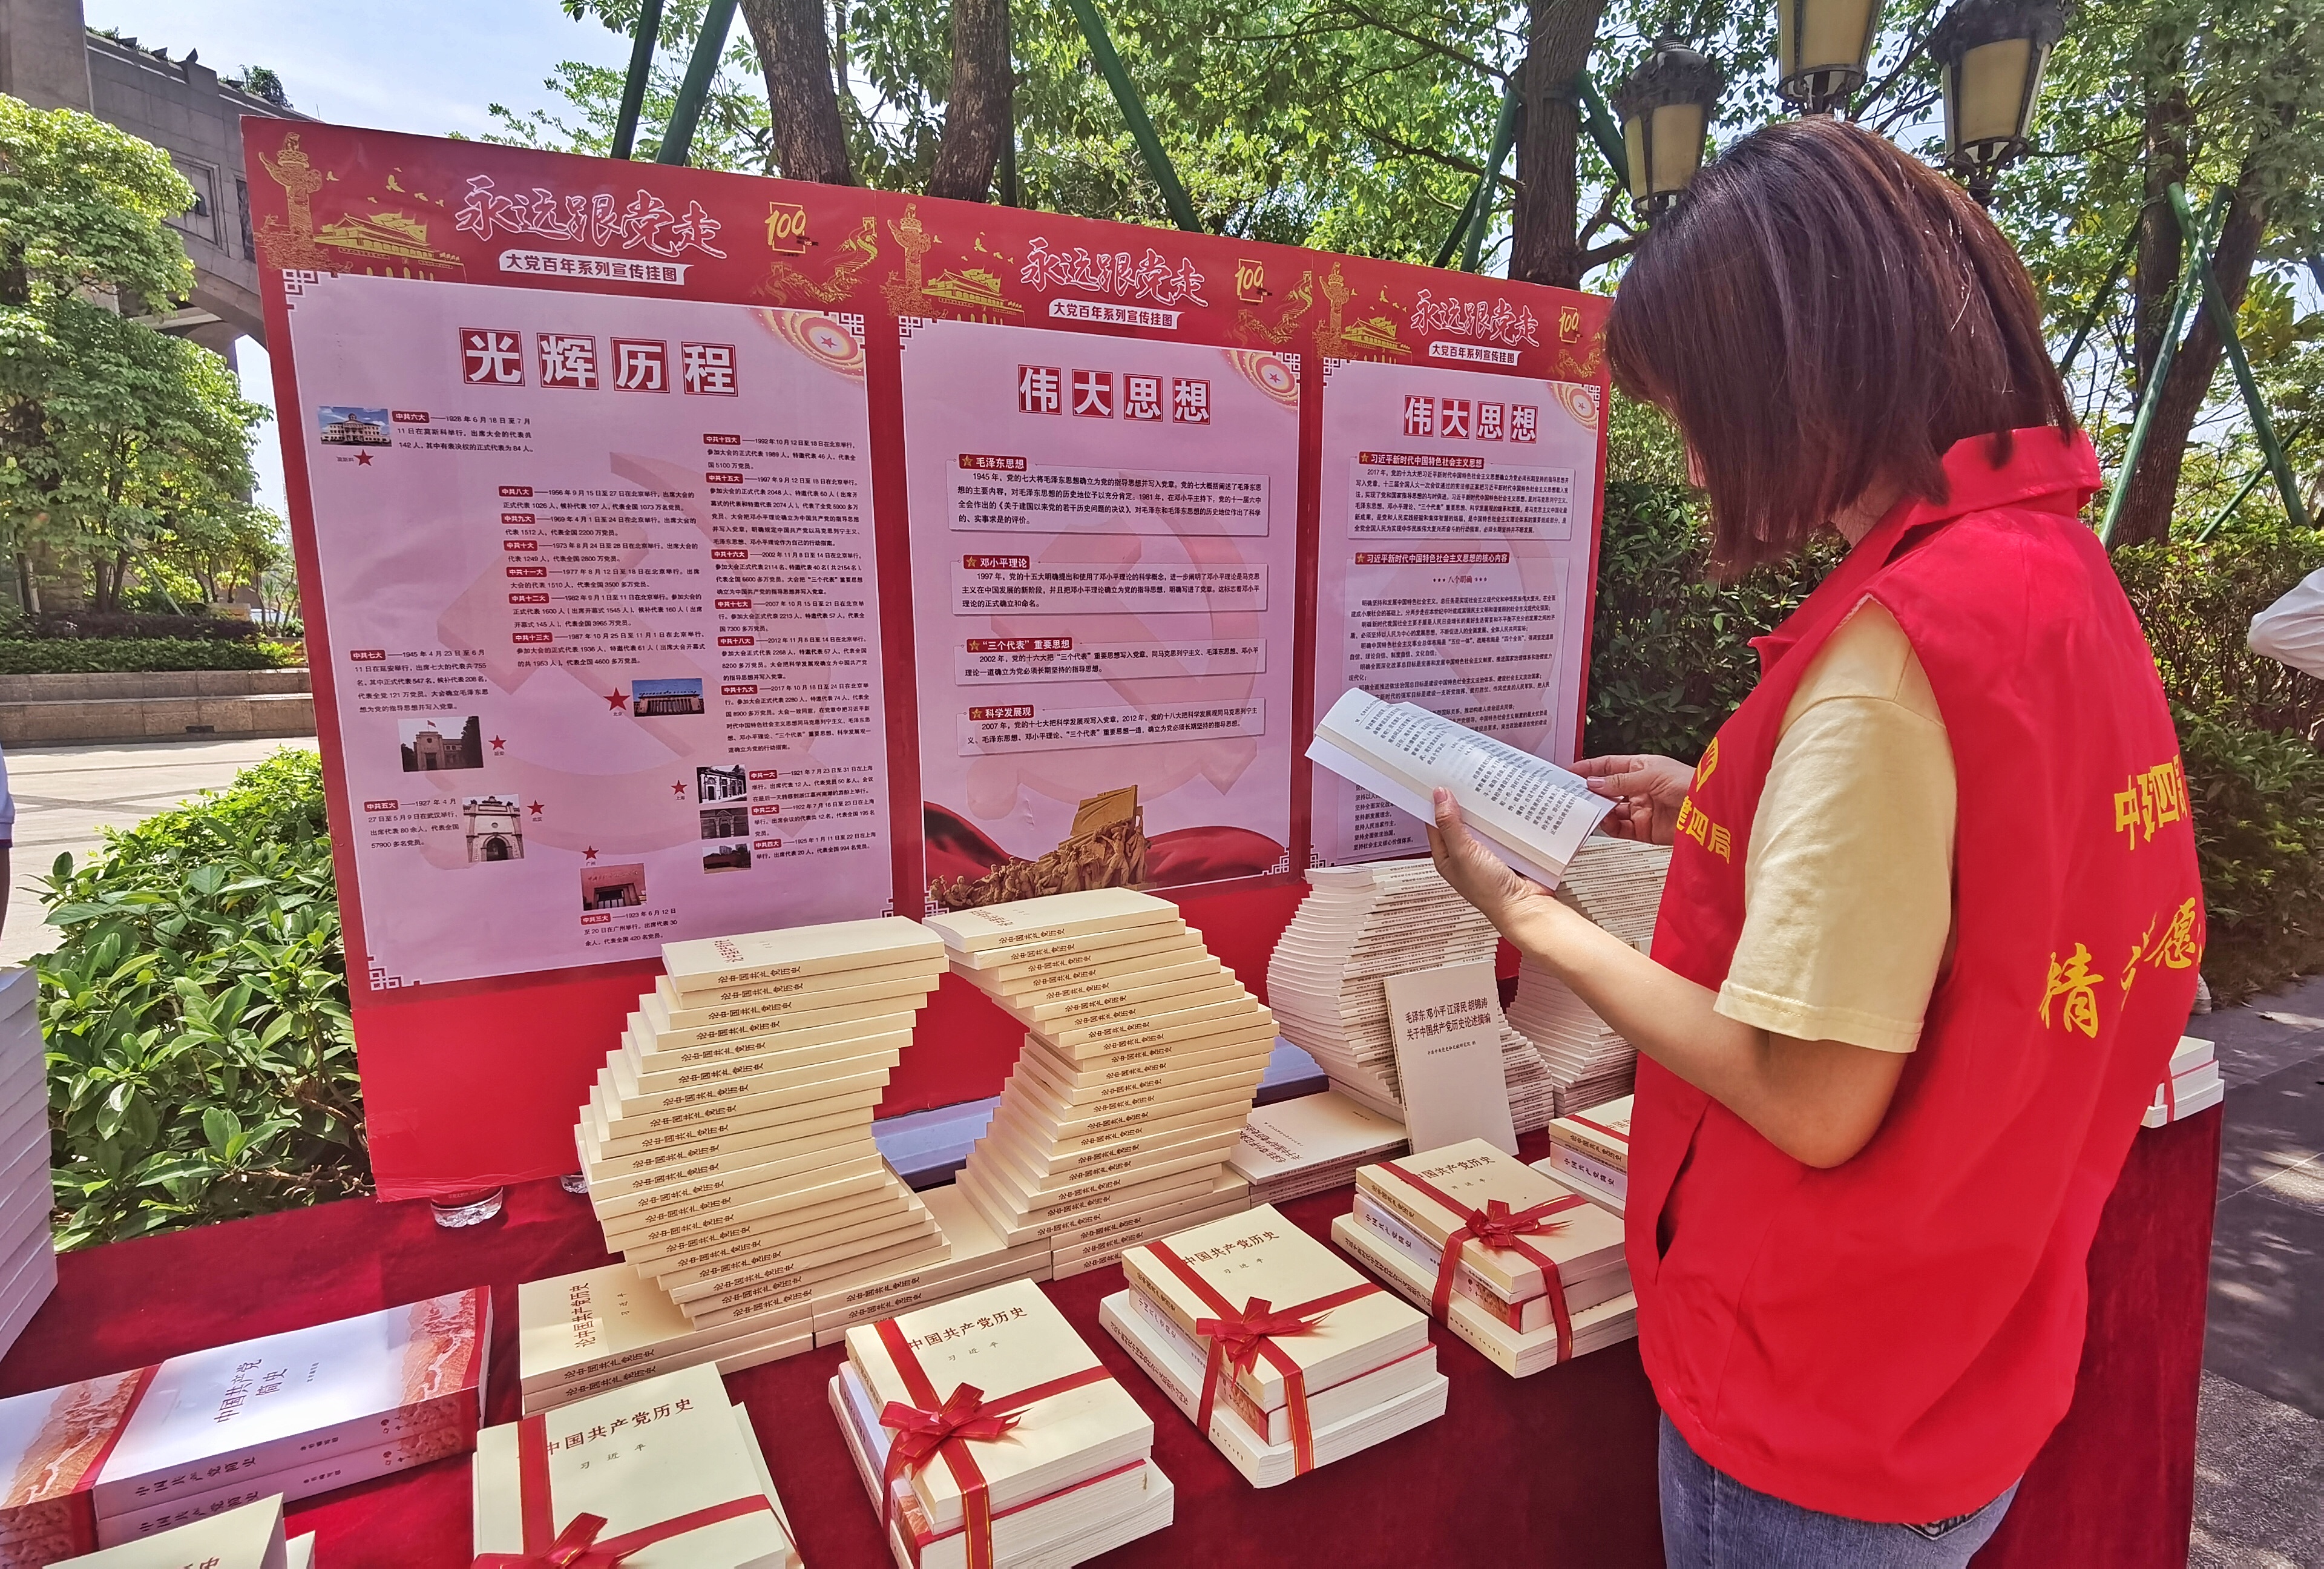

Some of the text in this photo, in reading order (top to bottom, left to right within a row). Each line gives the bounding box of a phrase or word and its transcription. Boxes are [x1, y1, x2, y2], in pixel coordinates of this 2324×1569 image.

[455, 174, 727, 258] 永远跟党走
[764, 210, 806, 246] 100
[506, 253, 678, 283] 大党百年系列宣传挂图
[1020, 237, 1209, 307] 永远跟党走
[1236, 265, 1264, 295] 100
[1054, 302, 1173, 327] 大党百年系列宣传挂图
[1411, 289, 1539, 347] 永远跟党走
[1558, 312, 1579, 337] 100
[465, 332, 735, 395] 光辉历程
[1432, 344, 1514, 364] 大党百年系列宣传挂图
[1020, 368, 1210, 423] 伟大思想
[1405, 398, 1537, 441] 伟大思想
[976, 458, 1024, 469] 毛泽东思想
[1371, 454, 1482, 468] 习近平新时代中国特色社会主义思想
[980, 558, 1027, 568] 邓小平理论
[985, 707, 1031, 717] 科学发展观
[999, 929, 1065, 944] 论中国共产党历史
[1011, 943, 1075, 959] 论中国共产党历史
[718, 965, 801, 984] 论中国共产党历史
[1028, 955, 1091, 972] 论中国共产党历史
[1033, 969, 1096, 987] 论中国共产党历史
[720, 982, 803, 1001] 论中国共产党历史
[1046, 982, 1109, 999] 论中国共产党历史
[708, 1001, 792, 1020] 论中国共产党历史
[1065, 995, 1127, 1013] 论中国共产党历史
[1405, 997, 1488, 1024] 毛泽东 邓小平 江泽民 胡锦涛
[1074, 1008, 1137, 1026] 论中国共产党历史
[1407, 1013, 1491, 1041] 关于中国共产党历史论述摘编
[696, 1020, 780, 1041] 论中国共产党历史
[1088, 1022, 1150, 1039] 论中国共产党历史
[1103, 1033, 1164, 1051] 论中国共产党历史
[681, 1041, 766, 1062] 论中国共产党历史
[1111, 1046, 1172, 1064] 论中国共产党历史
[678, 1062, 764, 1084] 论中国共产党历史
[1105, 1062, 1167, 1080] 论中国共产党历史
[663, 1083, 749, 1106] 论中国共产党历史
[1101, 1078, 1163, 1096] 论中国共产党历史
[650, 1104, 737, 1128] 论中国共产党历史
[1093, 1095, 1155, 1113] 论中国共产党历史
[1087, 1111, 1149, 1130] 论中国共产党历史
[642, 1123, 729, 1148] 论中国共产党历史
[1081, 1128, 1143, 1146] 论中国共产党历史
[1570, 1134, 1621, 1161] 论中国共产党历史
[632, 1143, 720, 1169] 论中国共产党历史
[1078, 1143, 1140, 1164] 论中国共产党历史
[632, 1162, 720, 1188] 论中国共产党历史
[1069, 1160, 1132, 1181] 论中国共产党历史
[638, 1180, 724, 1207] 论中国共产党历史
[1058, 1179, 1121, 1200] 论中国共产党历史
[645, 1196, 732, 1223] 论中国共产党历史
[1048, 1195, 1111, 1217] 论中国共产党历史
[1371, 1185, 1414, 1219] 论中国共产党历史
[648, 1214, 735, 1240] 论中国共产党历史
[1037, 1213, 1101, 1236] 论中国共产党历史
[1080, 1217, 1142, 1239] 论中国共产党历史
[666, 1225, 750, 1253] 论中国共产党历史
[1083, 1232, 1144, 1255] 论中国共产党历史
[678, 1240, 761, 1268] 论中国共产党历史
[699, 1250, 782, 1278] 论中国共产党历史
[713, 1263, 795, 1291] 论中国共产党历史
[721, 1275, 803, 1304] 论中国共产党历史
[847, 1276, 920, 1303] 论中国共产党历史
[733, 1289, 812, 1317] 论中国共产党历史
[849, 1292, 922, 1320] 论中国共产党历史
[570, 1283, 596, 1348] 论中国共产党历史
[948, 1341, 999, 1361] 习近平
[565, 1349, 654, 1379] 论中国共产党历史
[214, 1359, 262, 1424] 中国共产党
[255, 1368, 288, 1396] 简史
[566, 1366, 656, 1396] 论中国共产党历史
[580, 1444, 646, 1470] 习近平
[136, 1456, 256, 1497] 中国共产党简史
